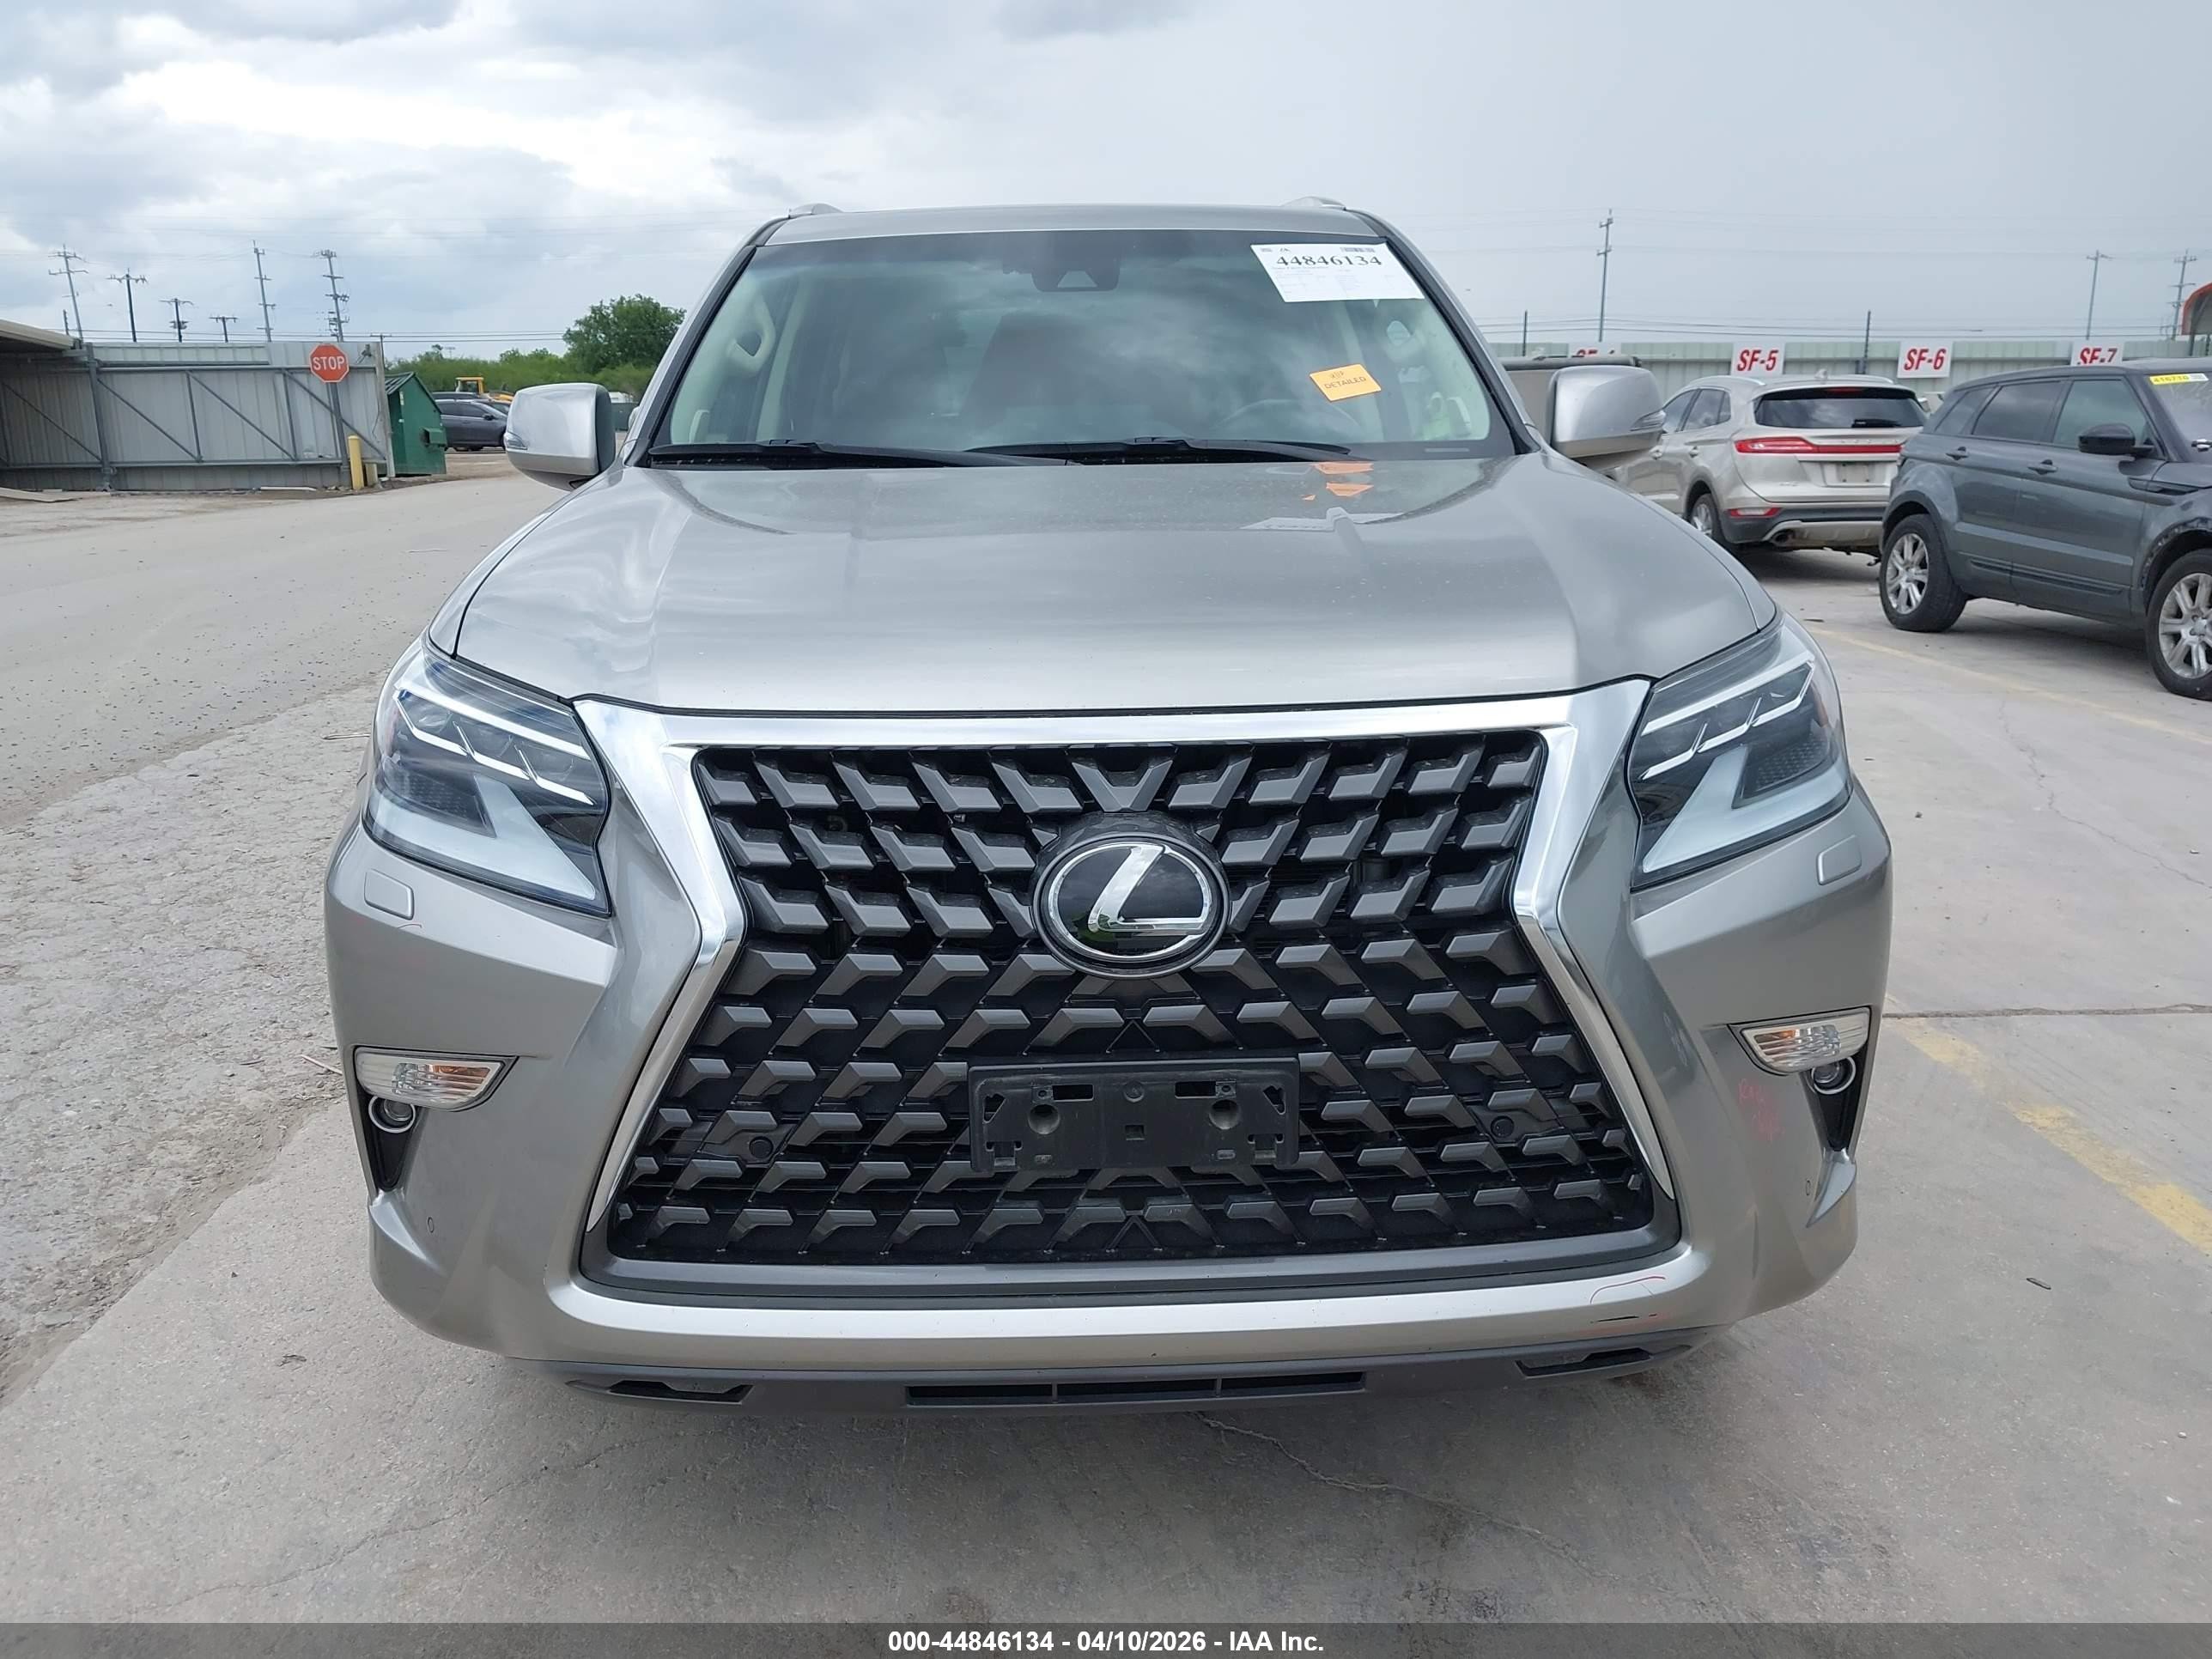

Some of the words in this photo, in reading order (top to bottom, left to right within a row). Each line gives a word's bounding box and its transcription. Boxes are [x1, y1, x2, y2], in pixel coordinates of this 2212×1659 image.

[1276, 255, 1383, 266] 44846134
[313, 356, 345, 371] STOP
[1737, 349, 1778, 372] SF-5
[1904, 348, 1947, 371] SF-6
[2078, 347, 2118, 364] SF-7
[1324, 376, 1367, 389] DETAILED
